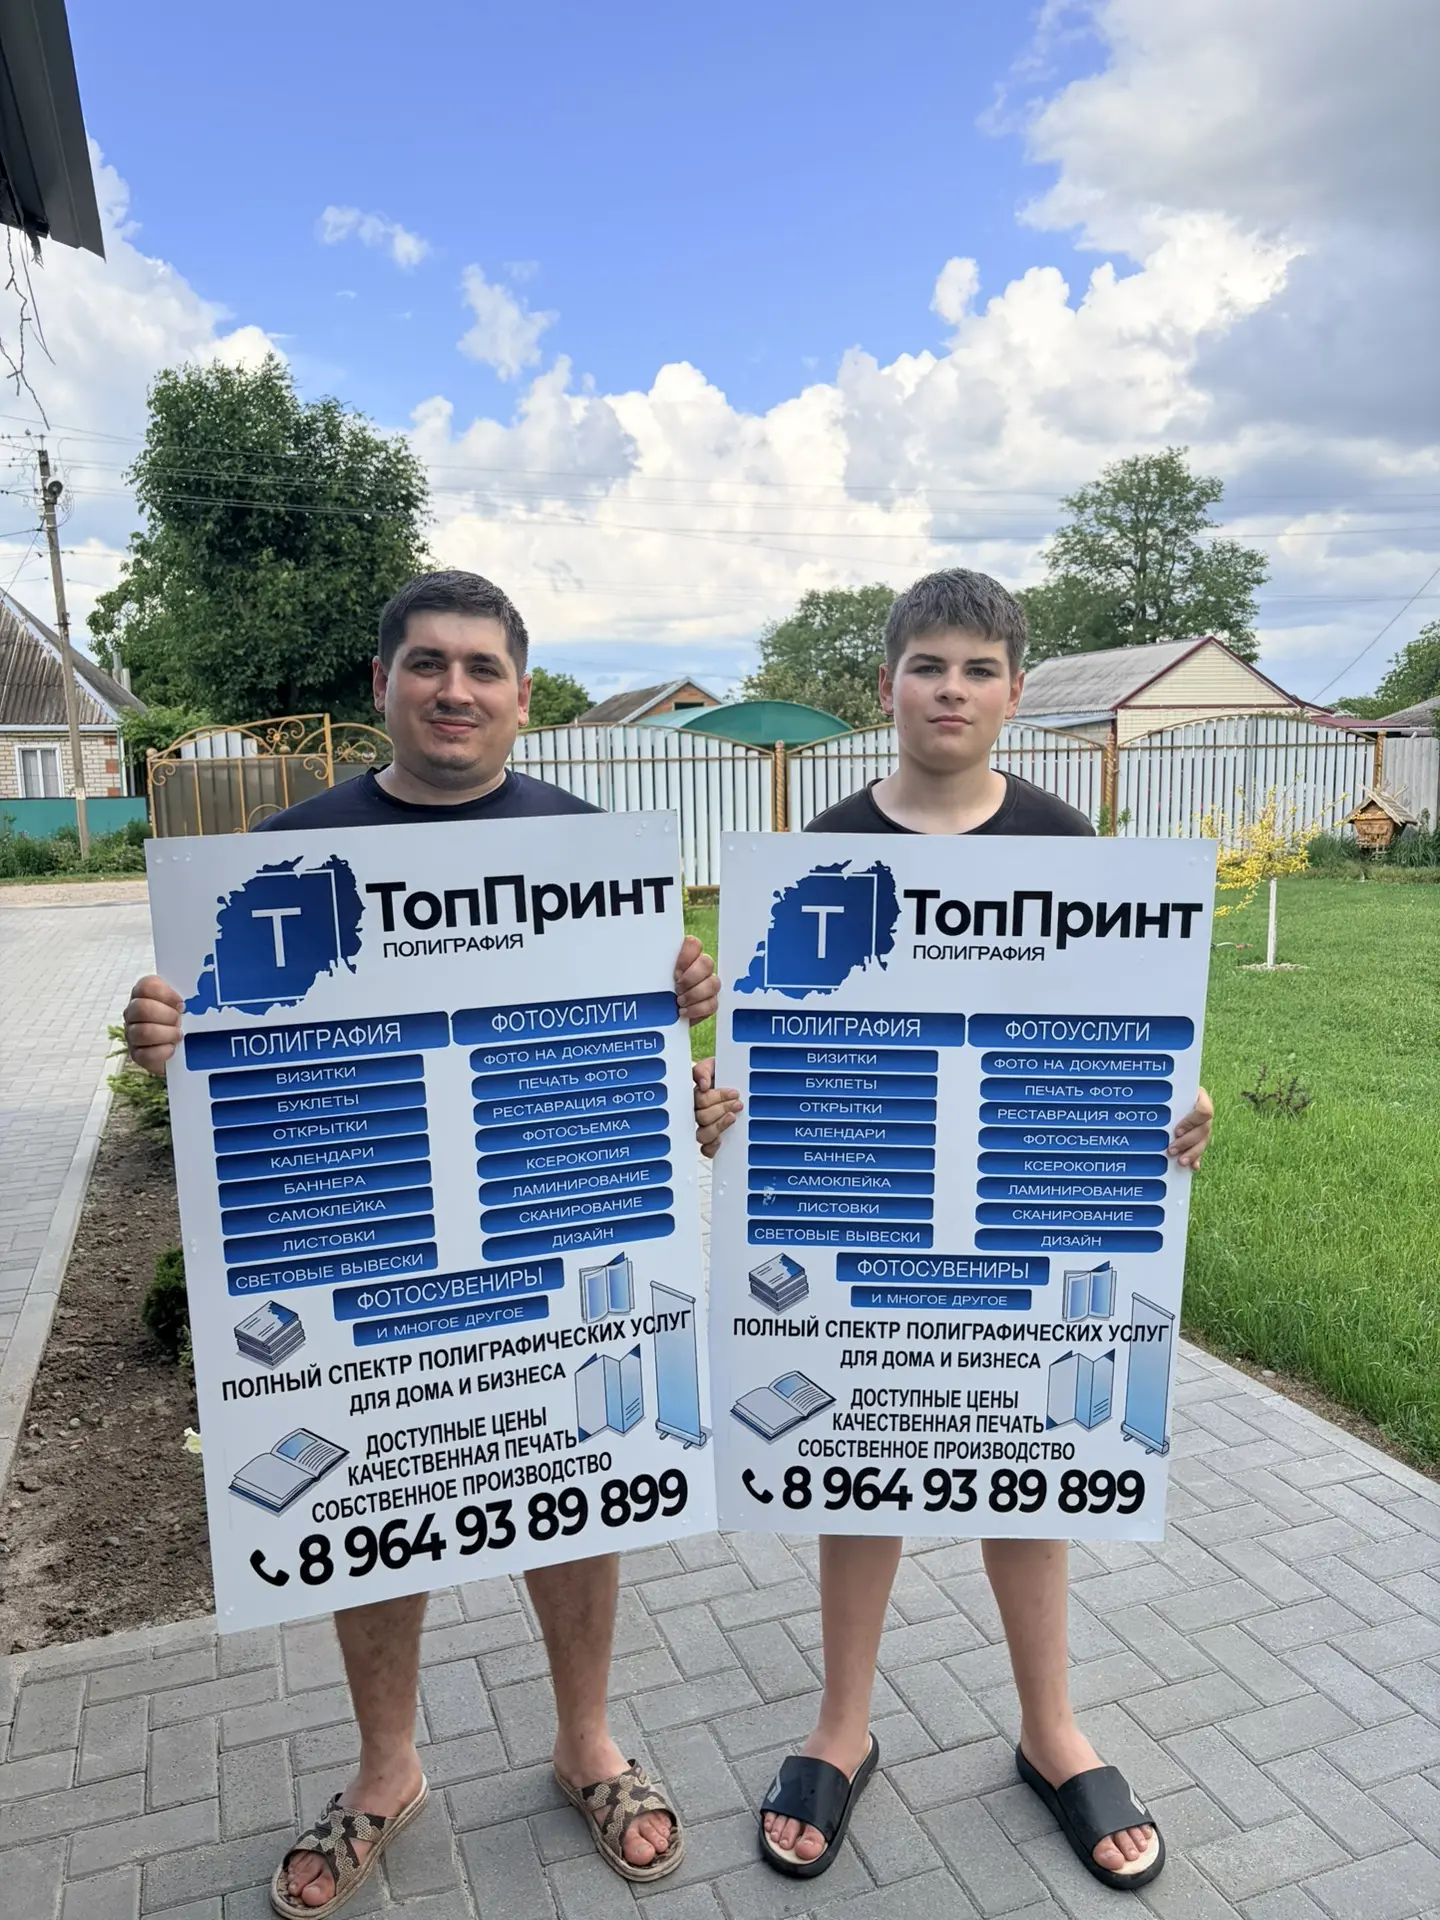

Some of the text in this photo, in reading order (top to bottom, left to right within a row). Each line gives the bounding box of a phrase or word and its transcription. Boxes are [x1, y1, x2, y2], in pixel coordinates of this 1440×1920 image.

[366, 875, 673, 934] ТопПринт
[903, 889, 1202, 949] ТопПринт
[383, 933, 523, 957] ПОЛИГРАФИЯ
[913, 944, 1044, 960] ПОЛИГРАФИЯ
[491, 1002, 637, 1033] ФОТОУСЛУГИ
[771, 1016, 920, 1037] ПОЛИГРАФИЯ
[231, 1022, 401, 1057] ПОЛИГРАФИЯ
[1005, 1021, 1149, 1041] ФОТОУСЛУГИ
[483, 1037, 656, 1064] ФОТО НА ДОКУМЕНТЫ
[807, 1053, 877, 1064] ВИЗИТКИ
[276, 1066, 356, 1084] ВИЗИТКИ
[994, 1058, 1165, 1072] ФОТО НА ДОКУМЕНТЫ
[518, 1067, 627, 1089] ПЕЧАТЬ ФОТО
[805, 1078, 876, 1089] БУКЛЕТЫ
[1025, 1084, 1133, 1096] ПЕЧАТЬ ФОТО
[277, 1093, 359, 1112] БУКЛЕТЫ
[492, 1090, 654, 1118] РЕСТАВРАЦИЯ ФОТО
[799, 1102, 881, 1113] ОТКРЫТКИ
[997, 1108, 1157, 1121] РЕСТАВРАЦИЯ ФОТО
[272, 1119, 367, 1139] ОТКРЫТКИ
[522, 1119, 630, 1140] ФОТОСЪЕМКА
[795, 1126, 885, 1139] КАЛЕНДАРИ
[1023, 1134, 1128, 1145] ФОТОСЪЕМКА
[271, 1146, 373, 1168] КАЛЕНДАРИ
[526, 1147, 630, 1169] КСЕРОКОПИЯ
[804, 1151, 875, 1162] БАННЕРА
[1024, 1160, 1125, 1171] КСЕРОКОПИЯ
[284, 1175, 365, 1193] БАННЕРА
[512, 1169, 649, 1197] ЛАМИНИРОВАНИЕ
[787, 1174, 891, 1187] САМОКЛЕЙКА
[1008, 1184, 1142, 1196] ЛАМИНИРОВАНИЕ
[267, 1198, 385, 1223] САМОКЛЕЙКА
[519, 1196, 642, 1222] СКАНИРОВАНИЕ
[797, 1201, 879, 1213] ЛИСТОВКИ
[1012, 1209, 1133, 1221] СКАНИРОВАНИЕ
[282, 1229, 375, 1251] ЛИСТОВКИ
[552, 1227, 613, 1247] ДИЗАЙН
[754, 1227, 920, 1243] СВЕТОВЫЕ ВЫВЕСКИ
[1041, 1234, 1101, 1247] ДИЗАЙН
[235, 1253, 423, 1289] СВЕТОВЫЕ ВЫВЕСКИ
[857, 1259, 1029, 1279] ФОТОСУВЕНИРЫ
[357, 1267, 543, 1308] ФОТОСУВЕНИРЫ
[871, 1293, 1007, 1306] И МНОГОЕ ДРУГОЕ
[377, 1306, 523, 1337] И МНОГОЕ ДРУГОЕ
[734, 1315, 1169, 1342] ПОЛНЫЙ СПЕКТР ПОЛИГРАФИЧЕСКИХ УСЛУГ
[222, 1309, 691, 1400] ПОЛНЫЙ СПЕКТР ПОЛИГРАФИЧЕСКИХ УСЛУГ
[840, 1350, 1040, 1368] ДЛЯ ДОМА И БИЗНЕСА
[349, 1362, 565, 1414] ДЛЯ ДОМА И БИЗНЕСА
[851, 1389, 1018, 1411] ДОСТУПНЫЕ ЦЕНЫ
[366, 1406, 546, 1458] ДОСТУПНЫЕ ЦЕНЫ
[832, 1413, 1043, 1433] КАЧЕСТВЕННАЯ ПЕЧАТЬ
[347, 1429, 576, 1485] КАЧЕСТВЕННАЯ ПЕЧАТЬ
[798, 1439, 1074, 1461] СОБСТВЕННОЕ ПРОИЗВОДСТВО
[312, 1451, 611, 1523] СОБСТВЕННОЕ ПРОИЗВОДСТВО
[782, 1466, 1145, 1513] 8 964 93 89 899
[299, 1468, 688, 1585] 8 964 93 89 899
